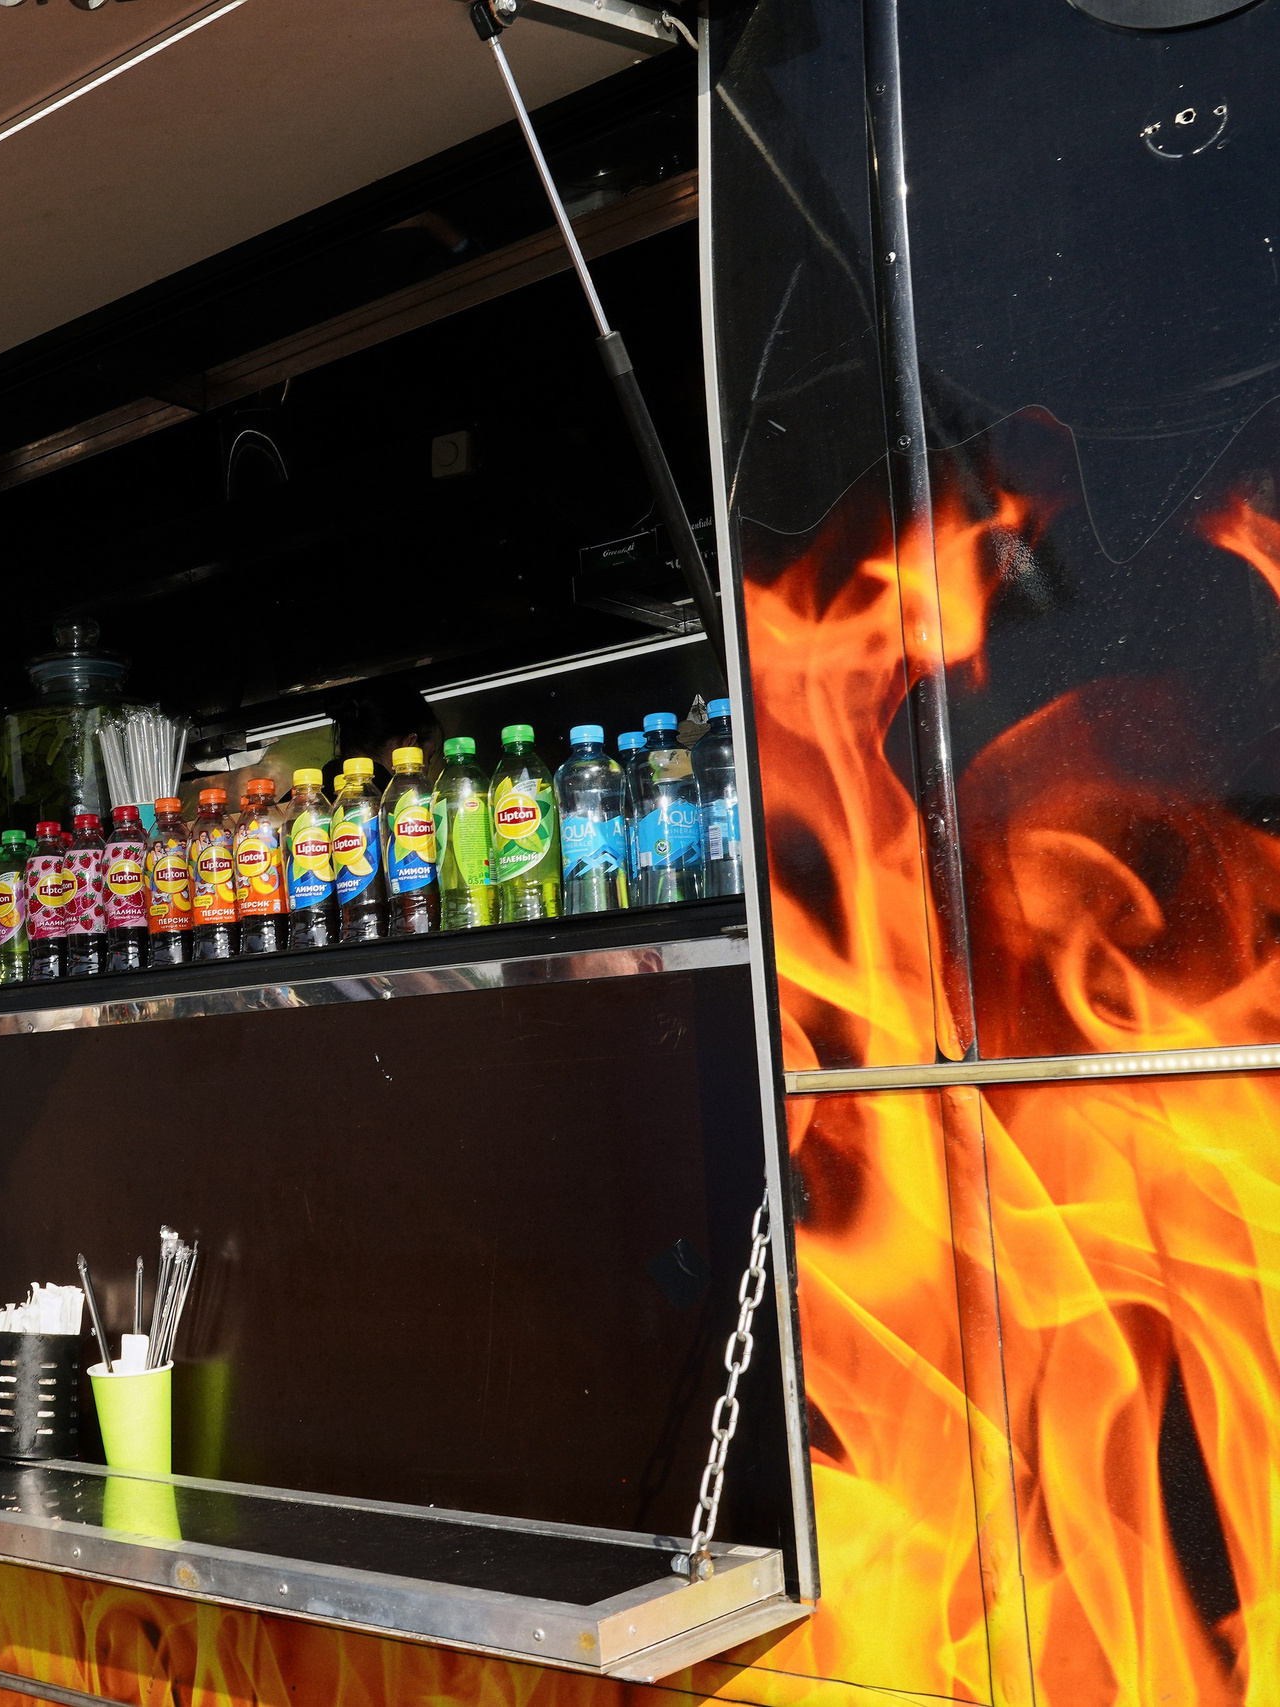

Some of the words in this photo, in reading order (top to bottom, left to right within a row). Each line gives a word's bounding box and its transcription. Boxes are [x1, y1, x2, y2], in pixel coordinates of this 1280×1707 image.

[499, 810, 534, 822] Lipton
[400, 824, 431, 835] Lipton
[297, 844, 328, 854] Lipton
[334, 839, 361, 850] Lipton
[239, 853, 266, 863] Lipton
[202, 861, 230, 870] Lipton
[111, 874, 138, 882] Lipton
[158, 871, 185, 880] Lipton
[41, 887, 63, 895] Lipto
